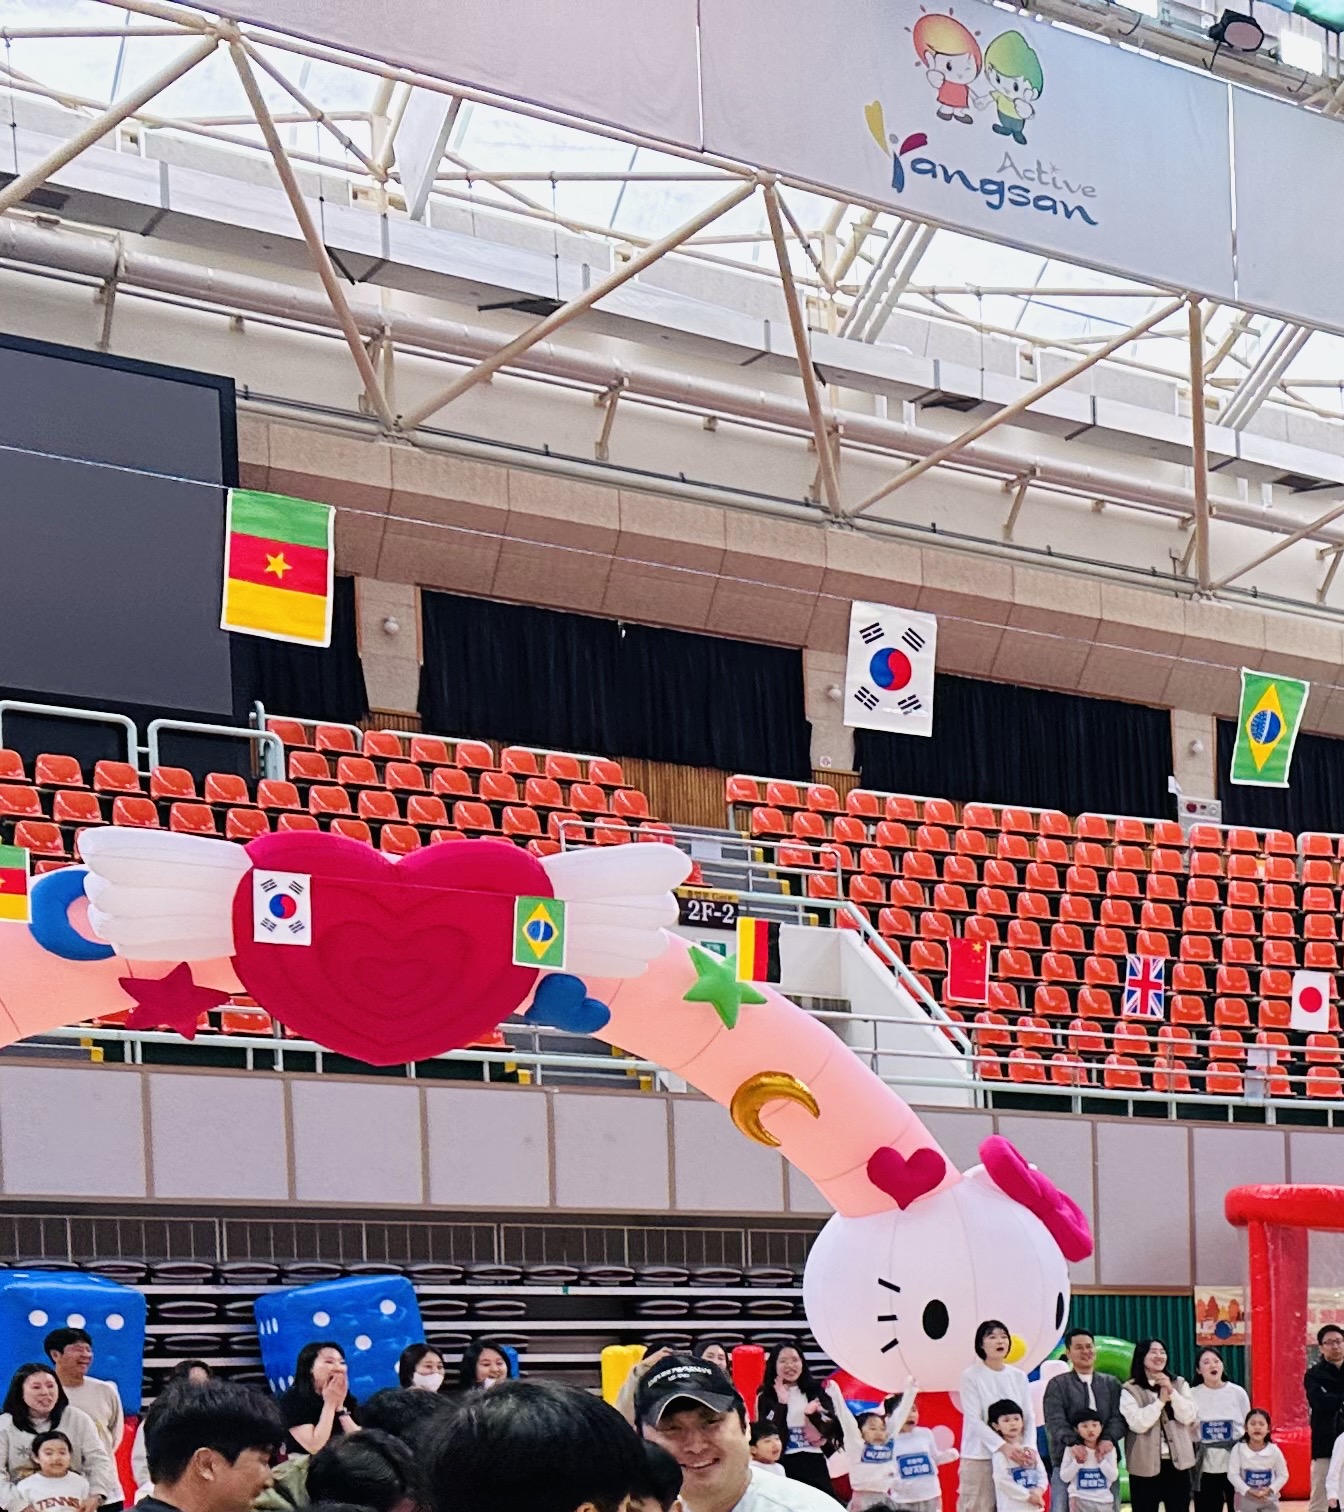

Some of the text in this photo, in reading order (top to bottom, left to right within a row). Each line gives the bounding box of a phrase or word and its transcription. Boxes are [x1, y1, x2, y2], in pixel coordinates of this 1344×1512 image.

[864, 100, 1098, 225] Yangsan
[997, 151, 1097, 198] Active
[688, 900, 735, 924] 2F-2
[36, 1496, 80, 1510] TENNIS
